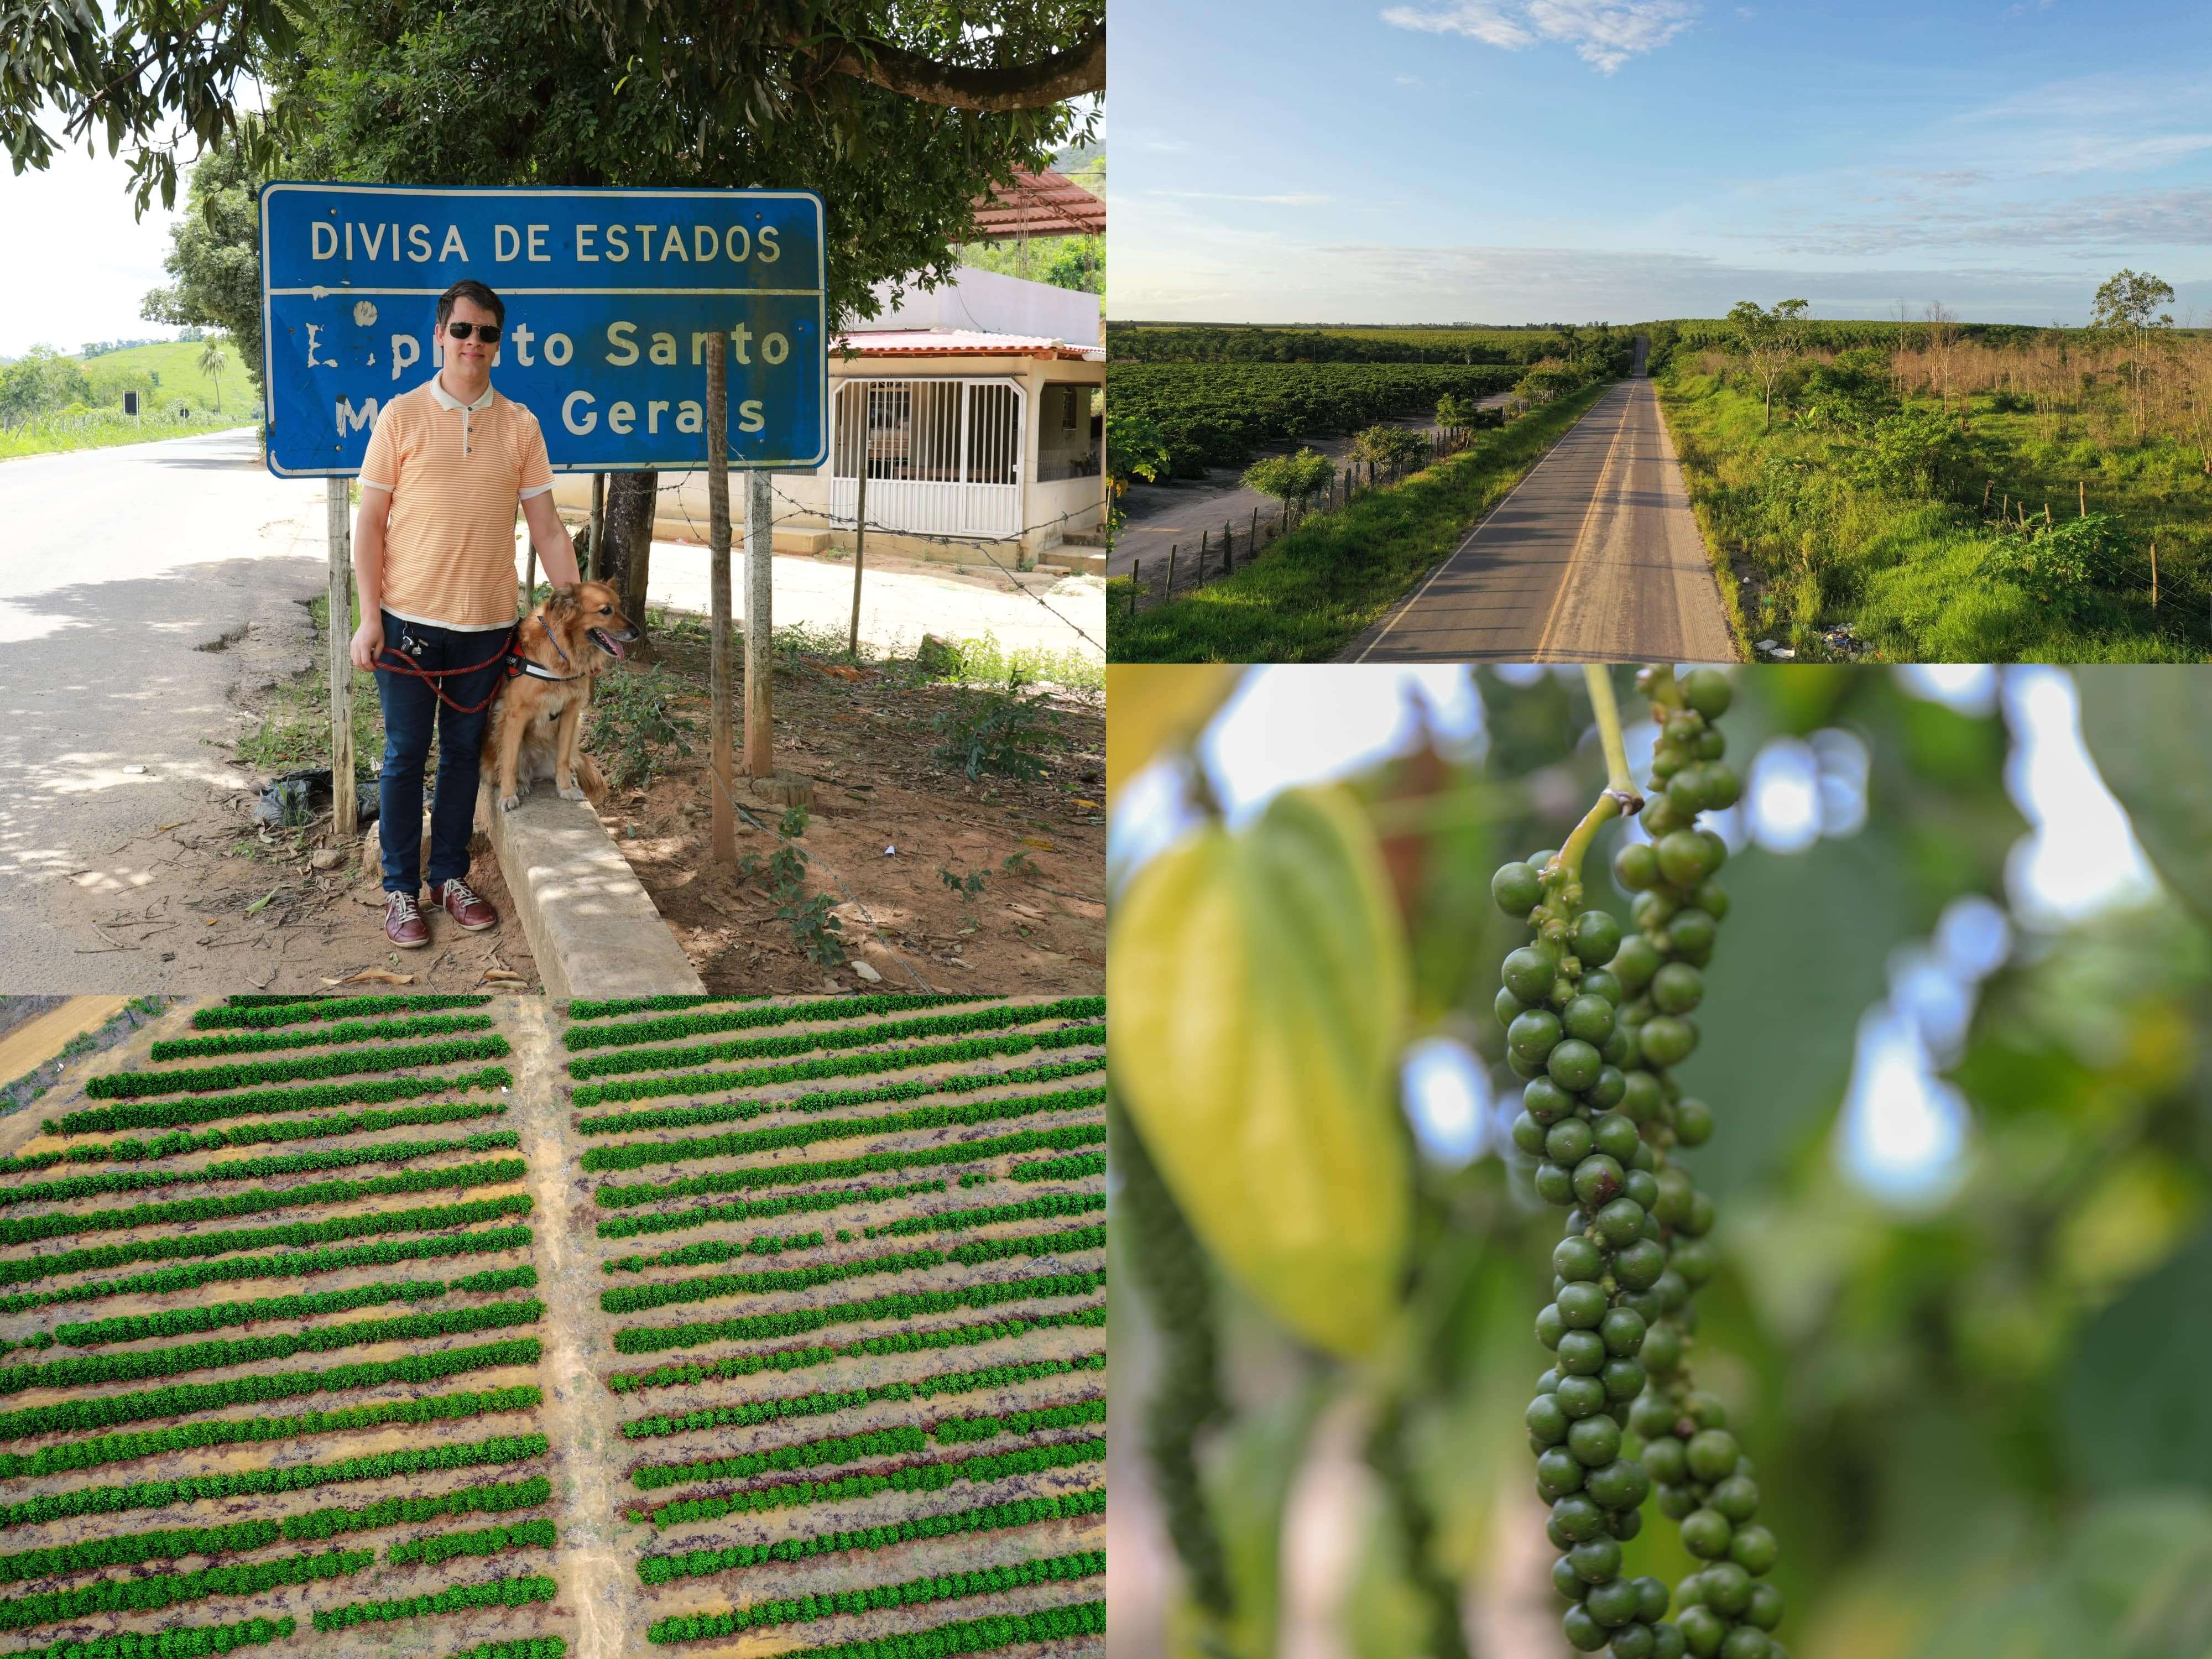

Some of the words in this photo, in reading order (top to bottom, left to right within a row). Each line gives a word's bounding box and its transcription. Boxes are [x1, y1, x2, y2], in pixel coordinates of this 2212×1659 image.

[311, 221, 469, 262] DIVISA
[495, 225, 551, 262] DE
[576, 225, 780, 263] ESTADOS
[562, 390, 765, 436] Geras
